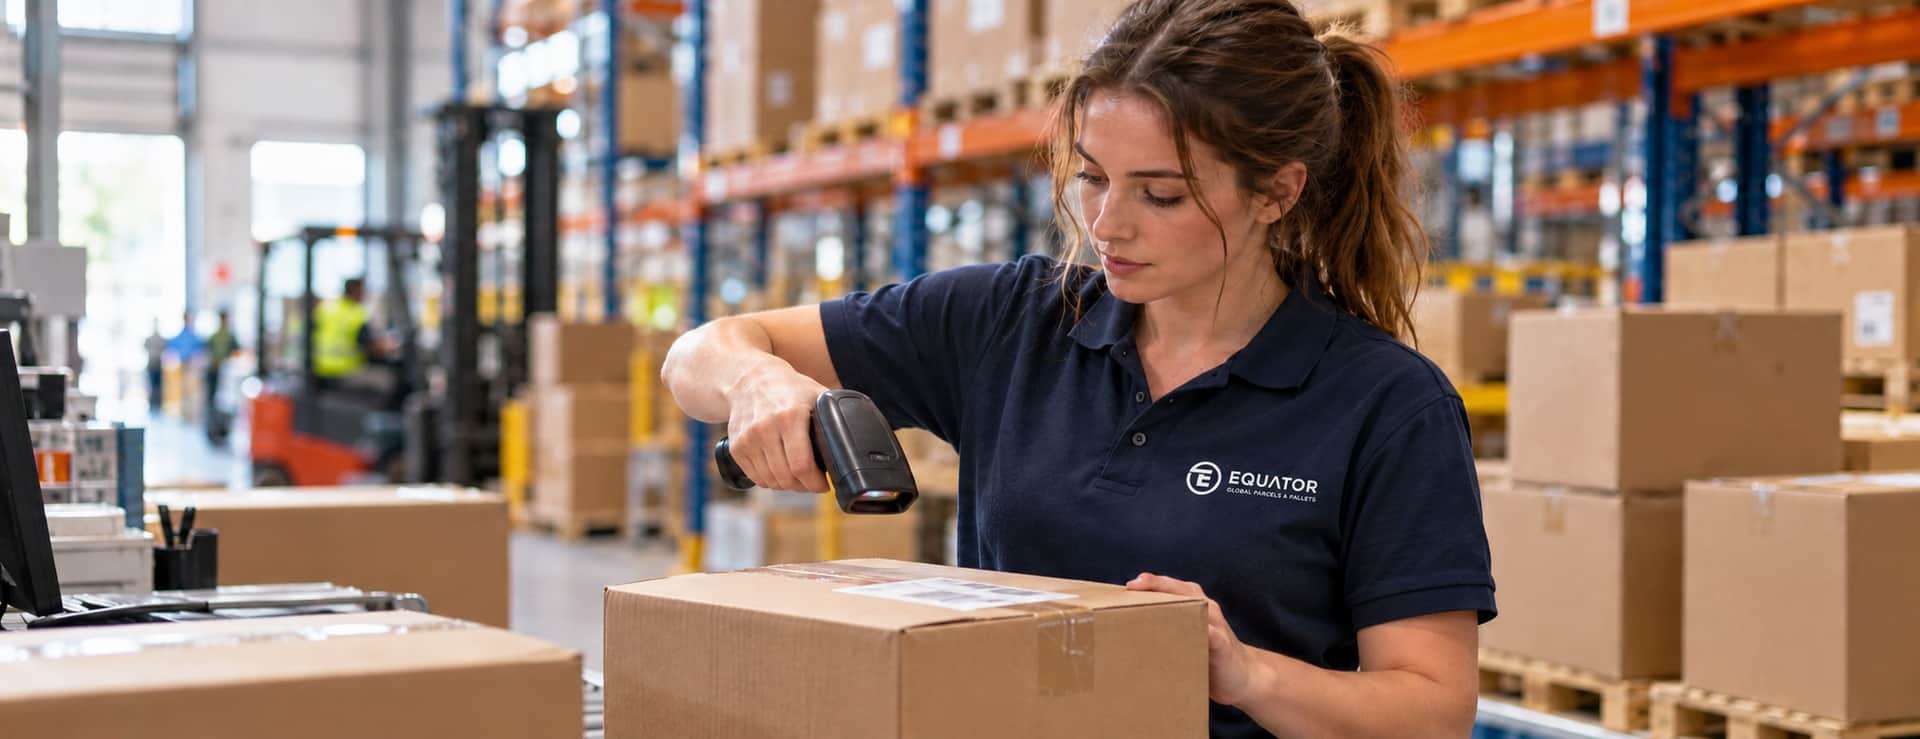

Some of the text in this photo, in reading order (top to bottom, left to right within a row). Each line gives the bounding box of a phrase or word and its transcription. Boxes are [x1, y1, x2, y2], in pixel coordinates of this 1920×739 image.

[1228, 471, 1318, 494] EQUATOR
[1226, 487, 1252, 496] GLOBAL
[1253, 490, 1282, 499] PARCELS
[1289, 494, 1317, 503] PALLETS
